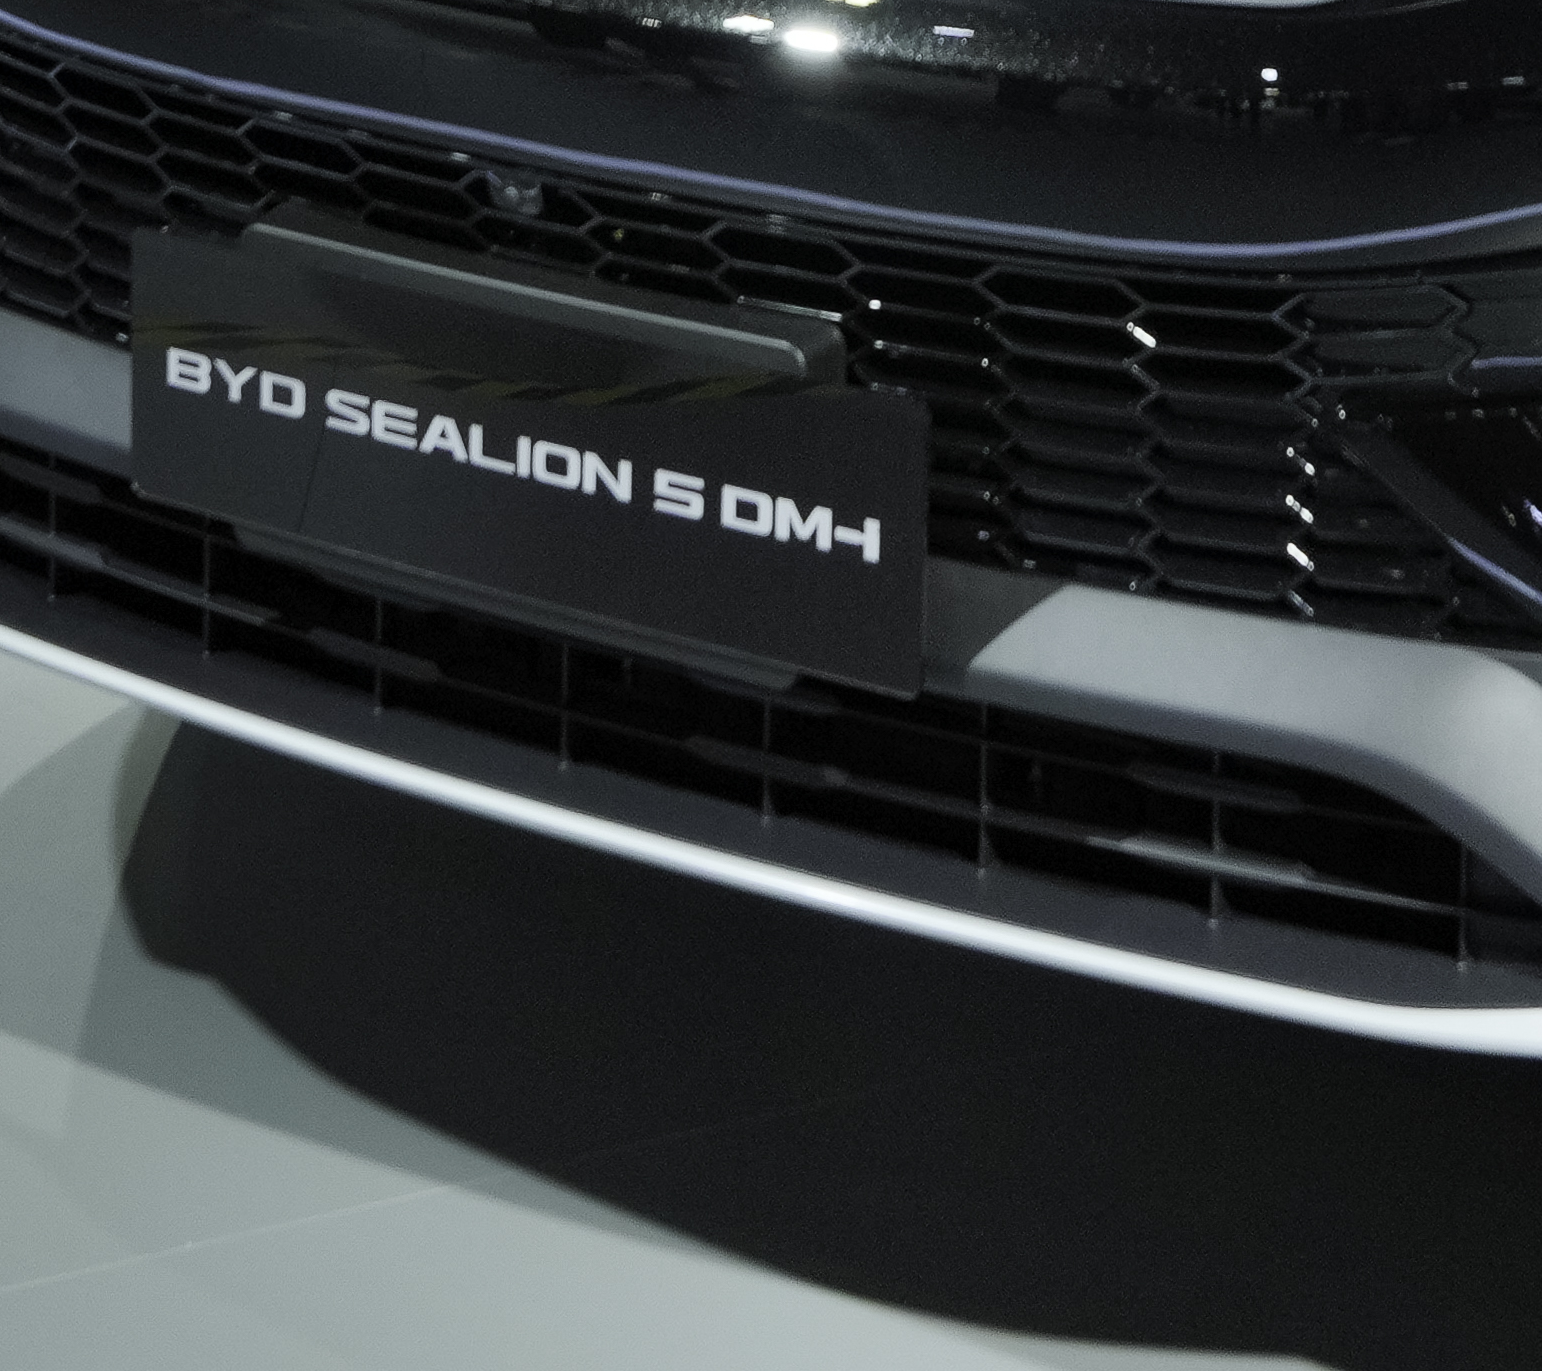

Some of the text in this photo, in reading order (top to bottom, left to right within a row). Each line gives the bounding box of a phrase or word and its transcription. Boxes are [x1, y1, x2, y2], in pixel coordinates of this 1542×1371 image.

[164, 346, 307, 421] BYD
[325, 389, 633, 506] SEALION
[653, 474, 706, 520] 5
